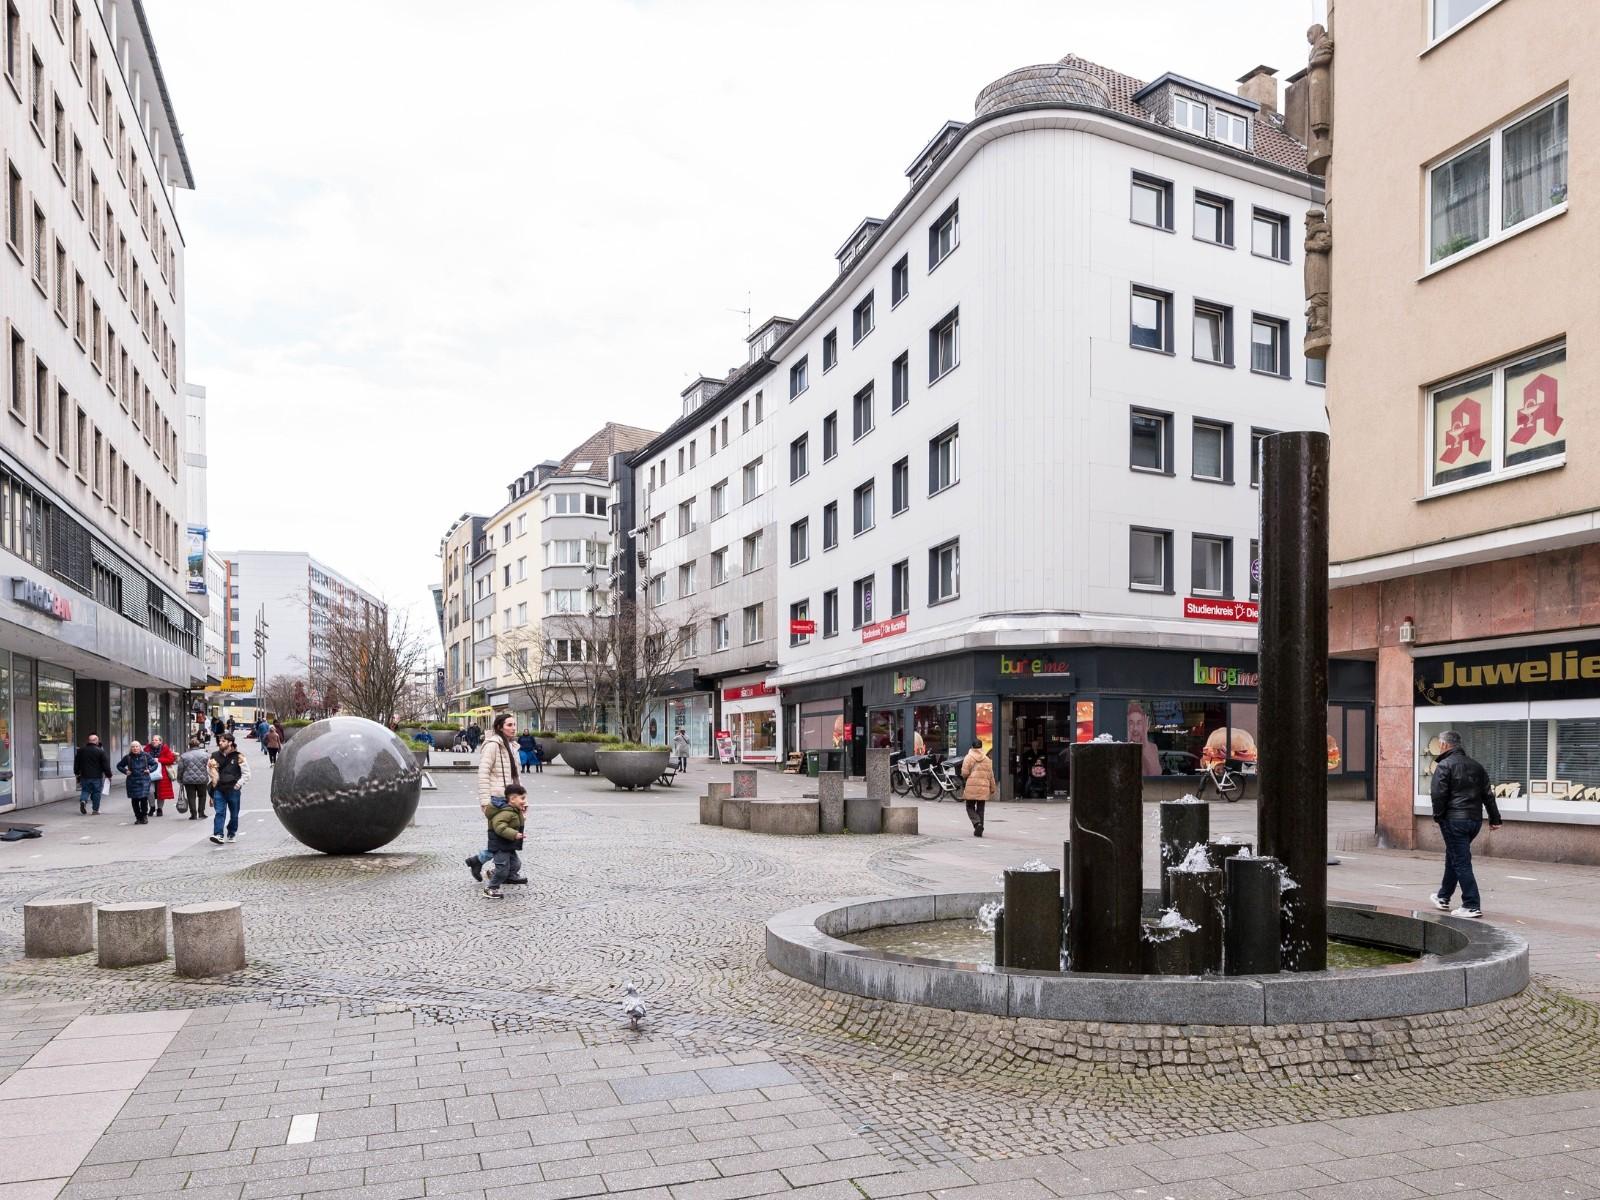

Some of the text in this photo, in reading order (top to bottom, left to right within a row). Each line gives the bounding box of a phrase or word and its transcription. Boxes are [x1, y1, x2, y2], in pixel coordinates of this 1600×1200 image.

[1187, 603, 1234, 616] Studienkreis
[1001, 654, 1070, 675] bureme
[1434, 650, 1600, 689] Juwelie
